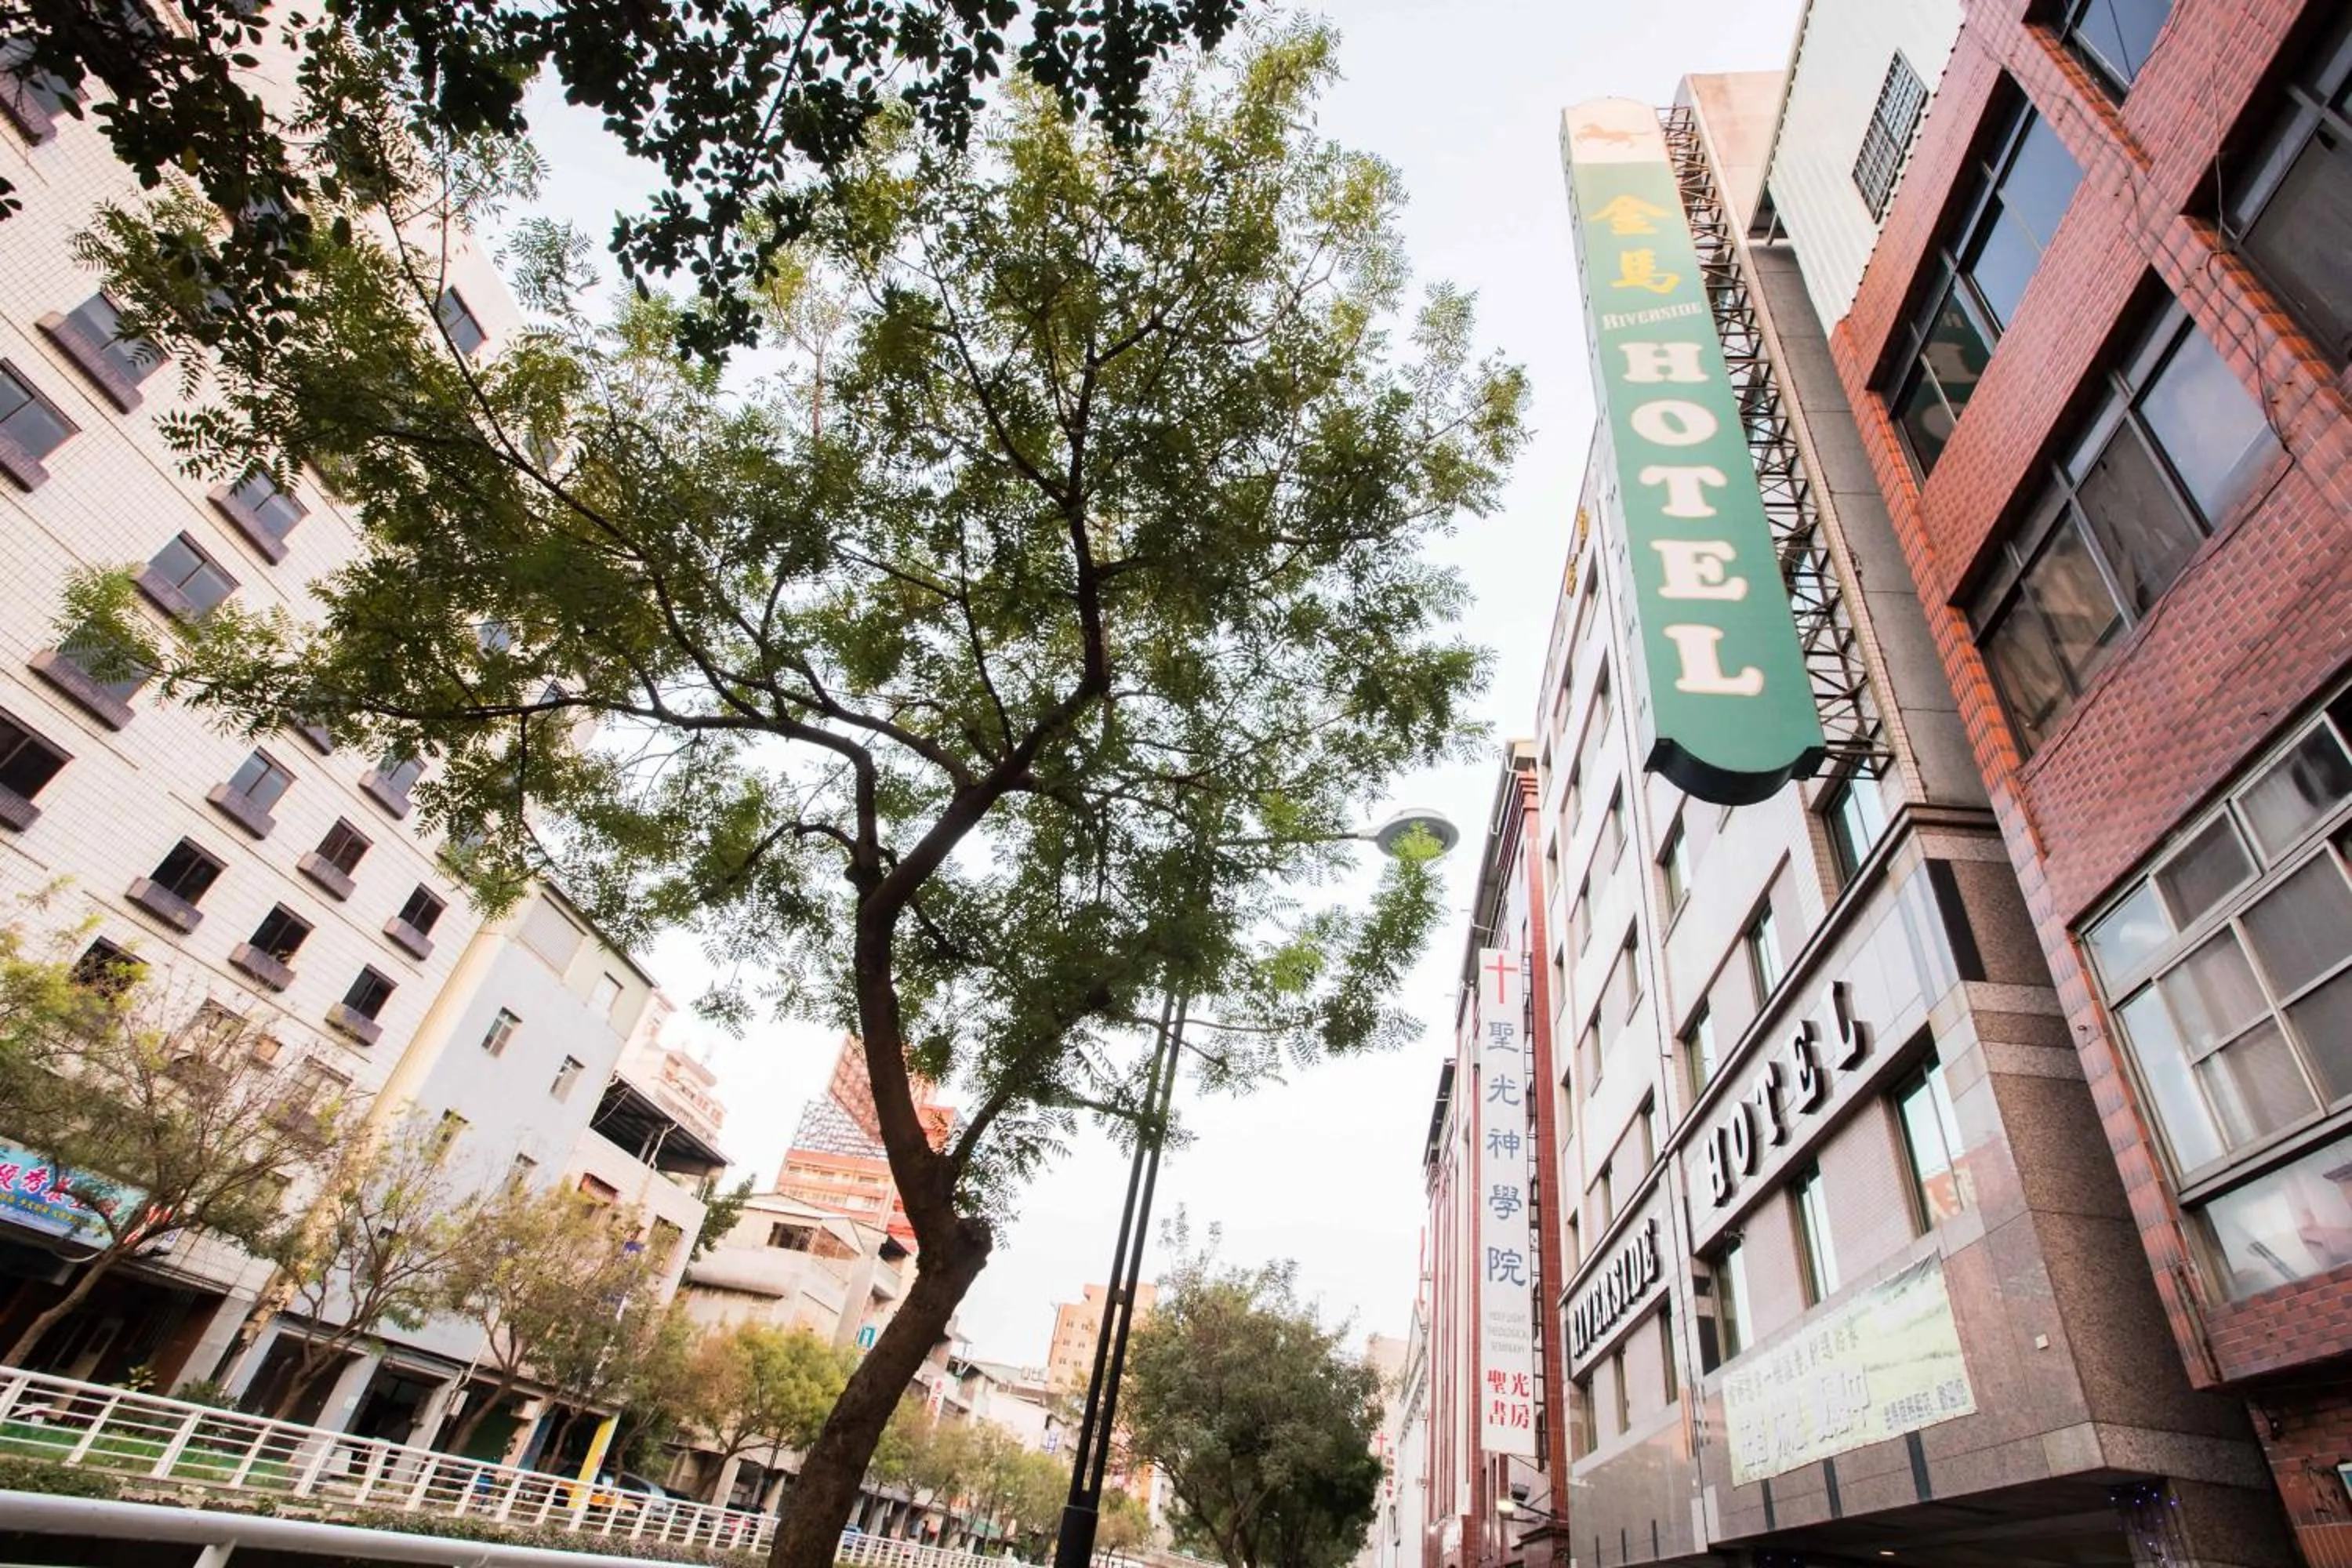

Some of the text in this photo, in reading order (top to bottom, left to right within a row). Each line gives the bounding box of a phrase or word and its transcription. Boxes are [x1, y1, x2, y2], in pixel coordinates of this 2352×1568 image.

[1588, 194, 1681, 294] 金馬
[1617, 342, 1764, 696] HOTEL
[1486, 1022, 1526, 1287] 聖光神學院
[1704, 980, 1869, 1208] HOTEL
[1572, 1214, 1661, 1359] RIVERSIDE
[1487, 1369, 1530, 1398] 聖光
[1489, 1399, 1530, 1429] 書房
